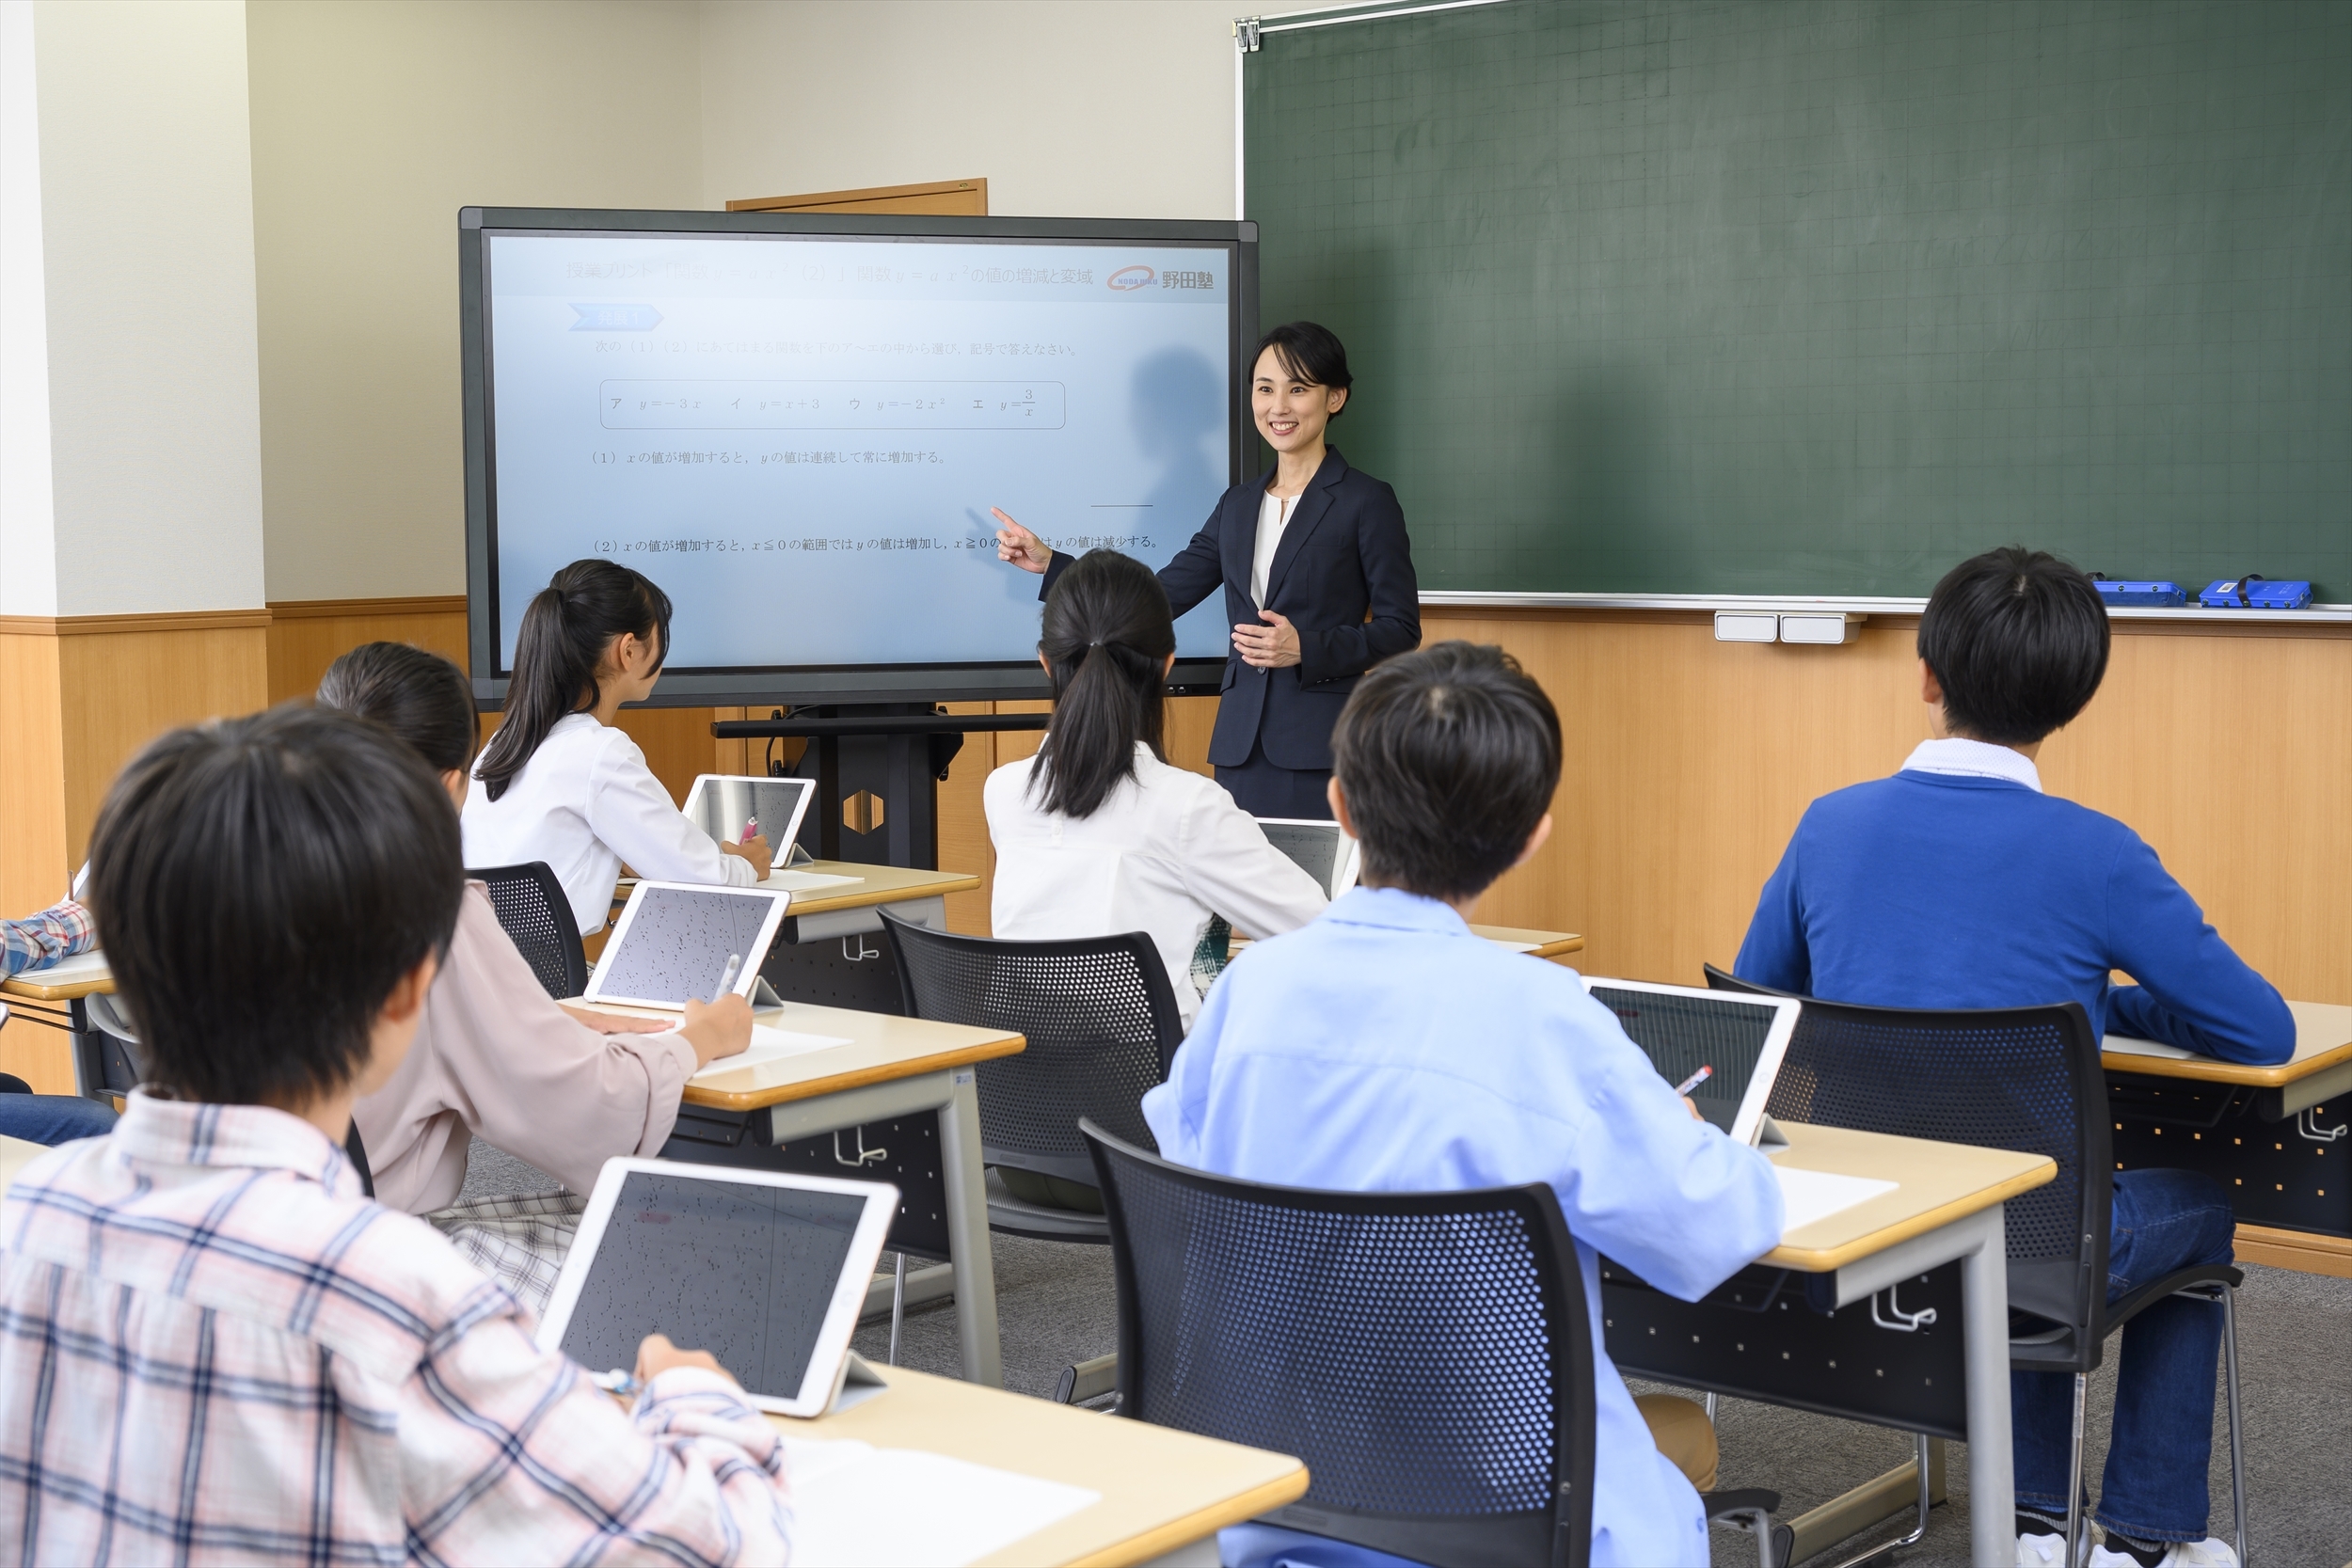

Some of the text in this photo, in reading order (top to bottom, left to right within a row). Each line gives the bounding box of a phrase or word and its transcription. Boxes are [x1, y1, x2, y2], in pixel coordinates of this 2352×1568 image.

[1162, 271, 1215, 290] 野田塾
[597, 310, 639, 325] 発展1
[611, 398, 622, 409] ア
[731, 398, 741, 409] イ
[849, 398, 861, 410] ウ
[973, 399, 984, 409] エ
